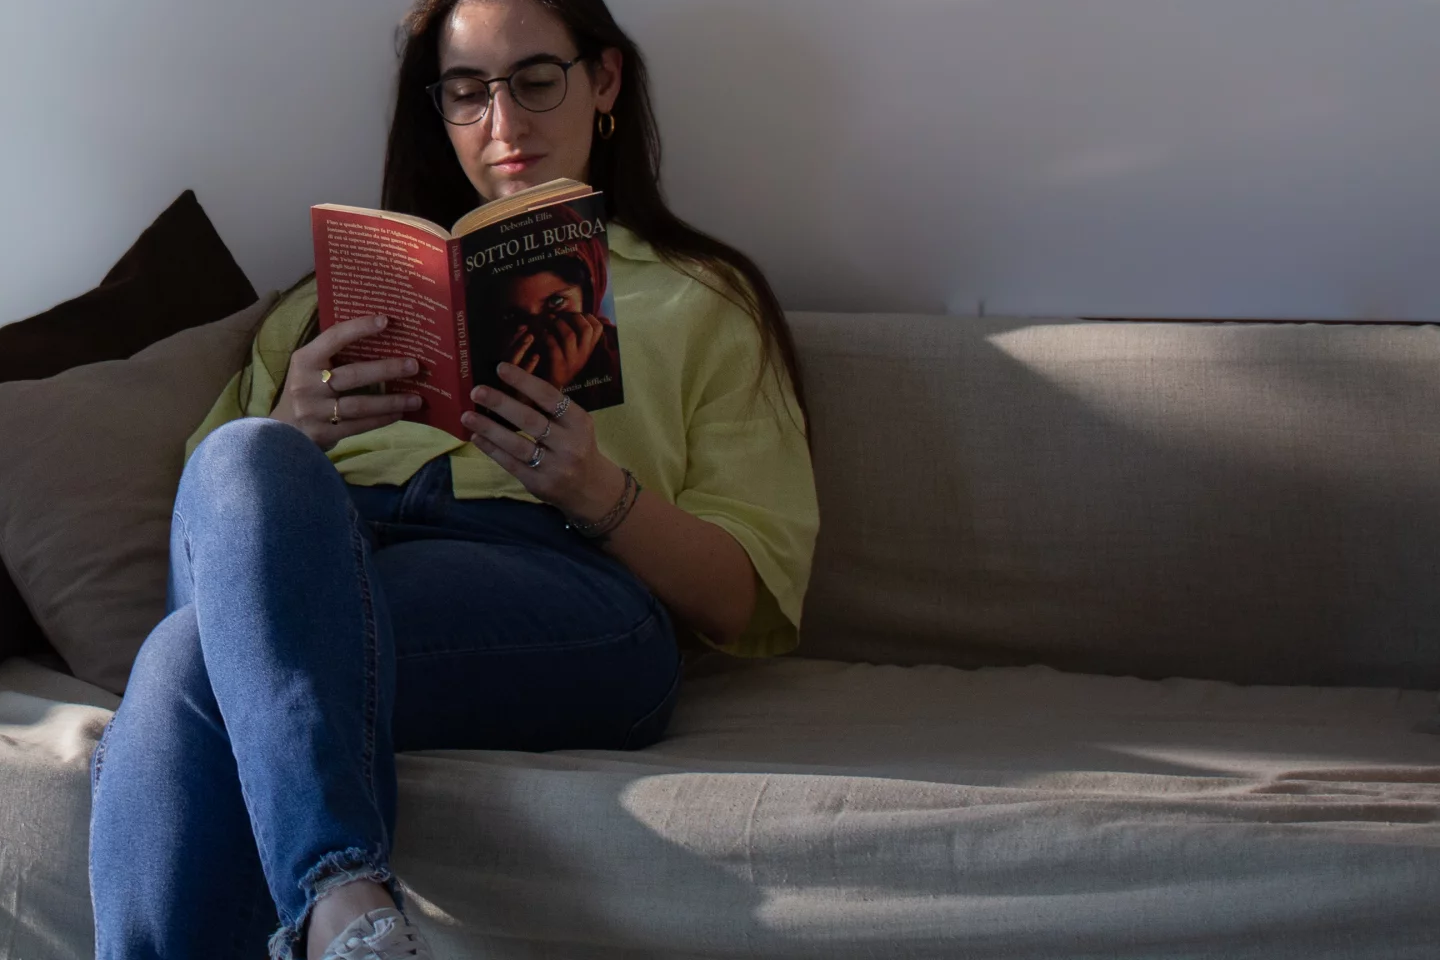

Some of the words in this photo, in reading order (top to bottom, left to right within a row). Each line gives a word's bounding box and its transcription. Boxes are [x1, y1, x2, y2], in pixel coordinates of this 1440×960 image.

[500, 217, 533, 234] Deborah
[535, 211, 553, 222] Ellis
[465, 239, 520, 272] SOTTO
[522, 233, 540, 252] IL
[542, 217, 606, 246] BURQA
[350, 251, 375, 259] settembre
[491, 262, 513, 275] Avere
[516, 259, 524, 267] 11
[527, 252, 545, 263] anni
[554, 243, 578, 256] Kabul
[353, 273, 384, 281] responsabile
[421, 275, 435, 284] guerra
[456, 310, 466, 338] SOTTO
[459, 340, 467, 349] IL
[460, 349, 469, 378] BURQA
[584, 374, 613, 388] difficile
